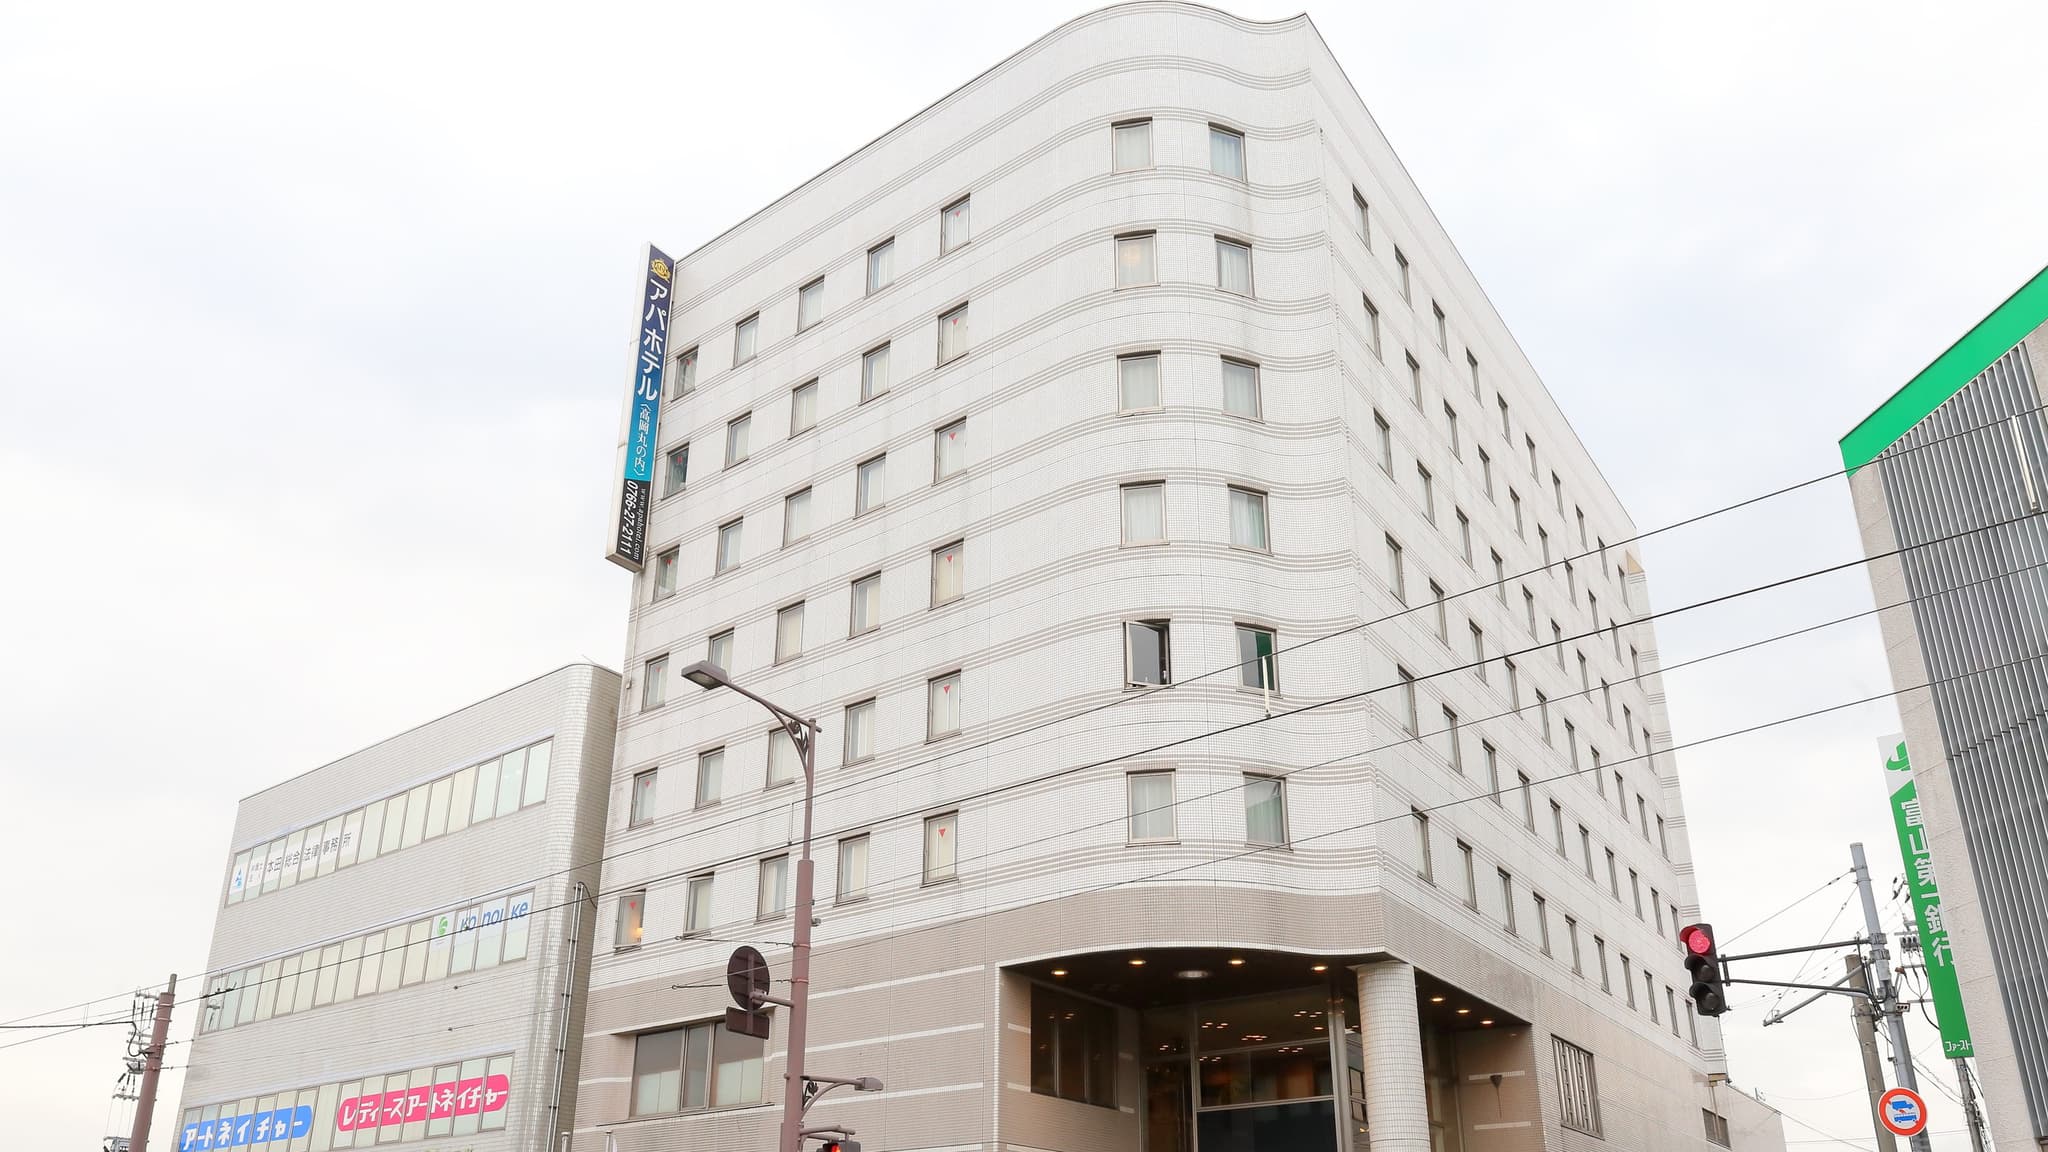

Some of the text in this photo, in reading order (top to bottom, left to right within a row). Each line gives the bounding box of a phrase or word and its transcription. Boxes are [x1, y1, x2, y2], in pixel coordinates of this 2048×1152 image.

[638, 278, 668, 401] アパホテル
[620, 480, 639, 554] 0766-27-2111
[183, 1116, 303, 1151] アートネイチャー
[342, 1085, 508, 1126] レディースアートネイチャー
